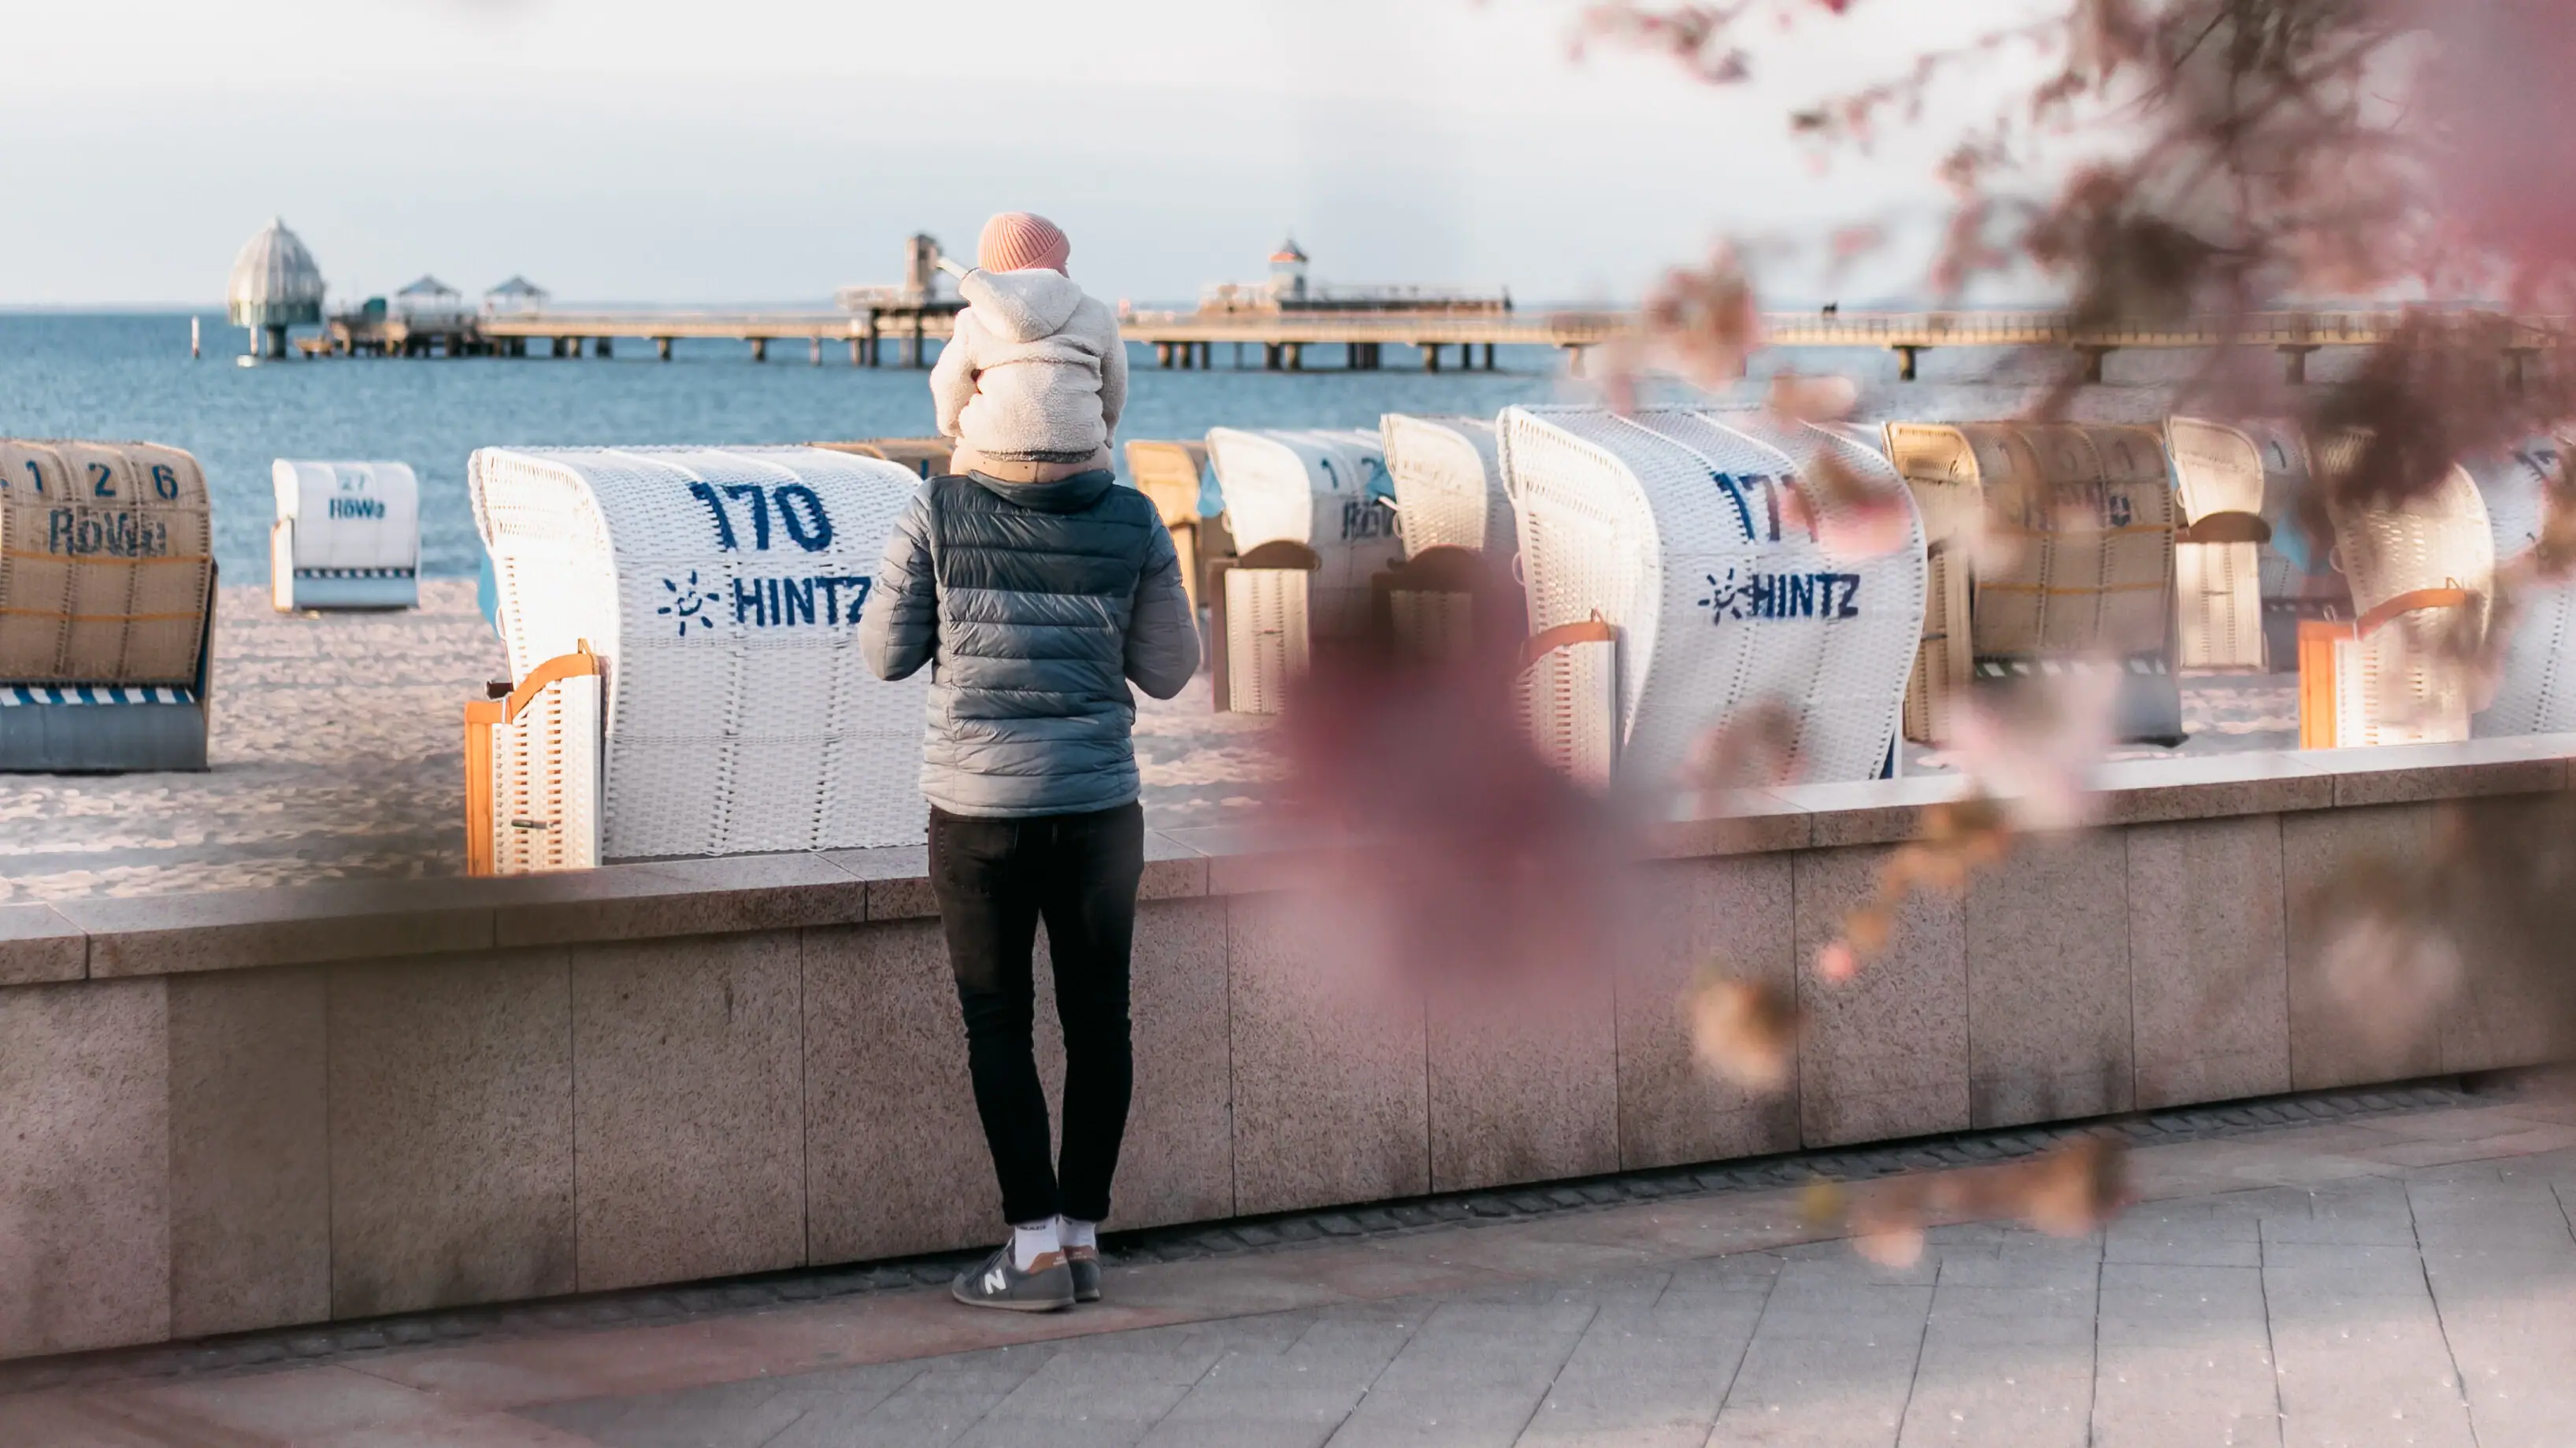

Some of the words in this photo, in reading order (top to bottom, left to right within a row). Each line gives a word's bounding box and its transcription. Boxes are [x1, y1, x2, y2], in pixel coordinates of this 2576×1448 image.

[686, 481, 832, 552] 170
[733, 576, 872, 627] HINTZ
[1751, 572, 1861, 619] HINTZ
[984, 1268, 1006, 1294] N
